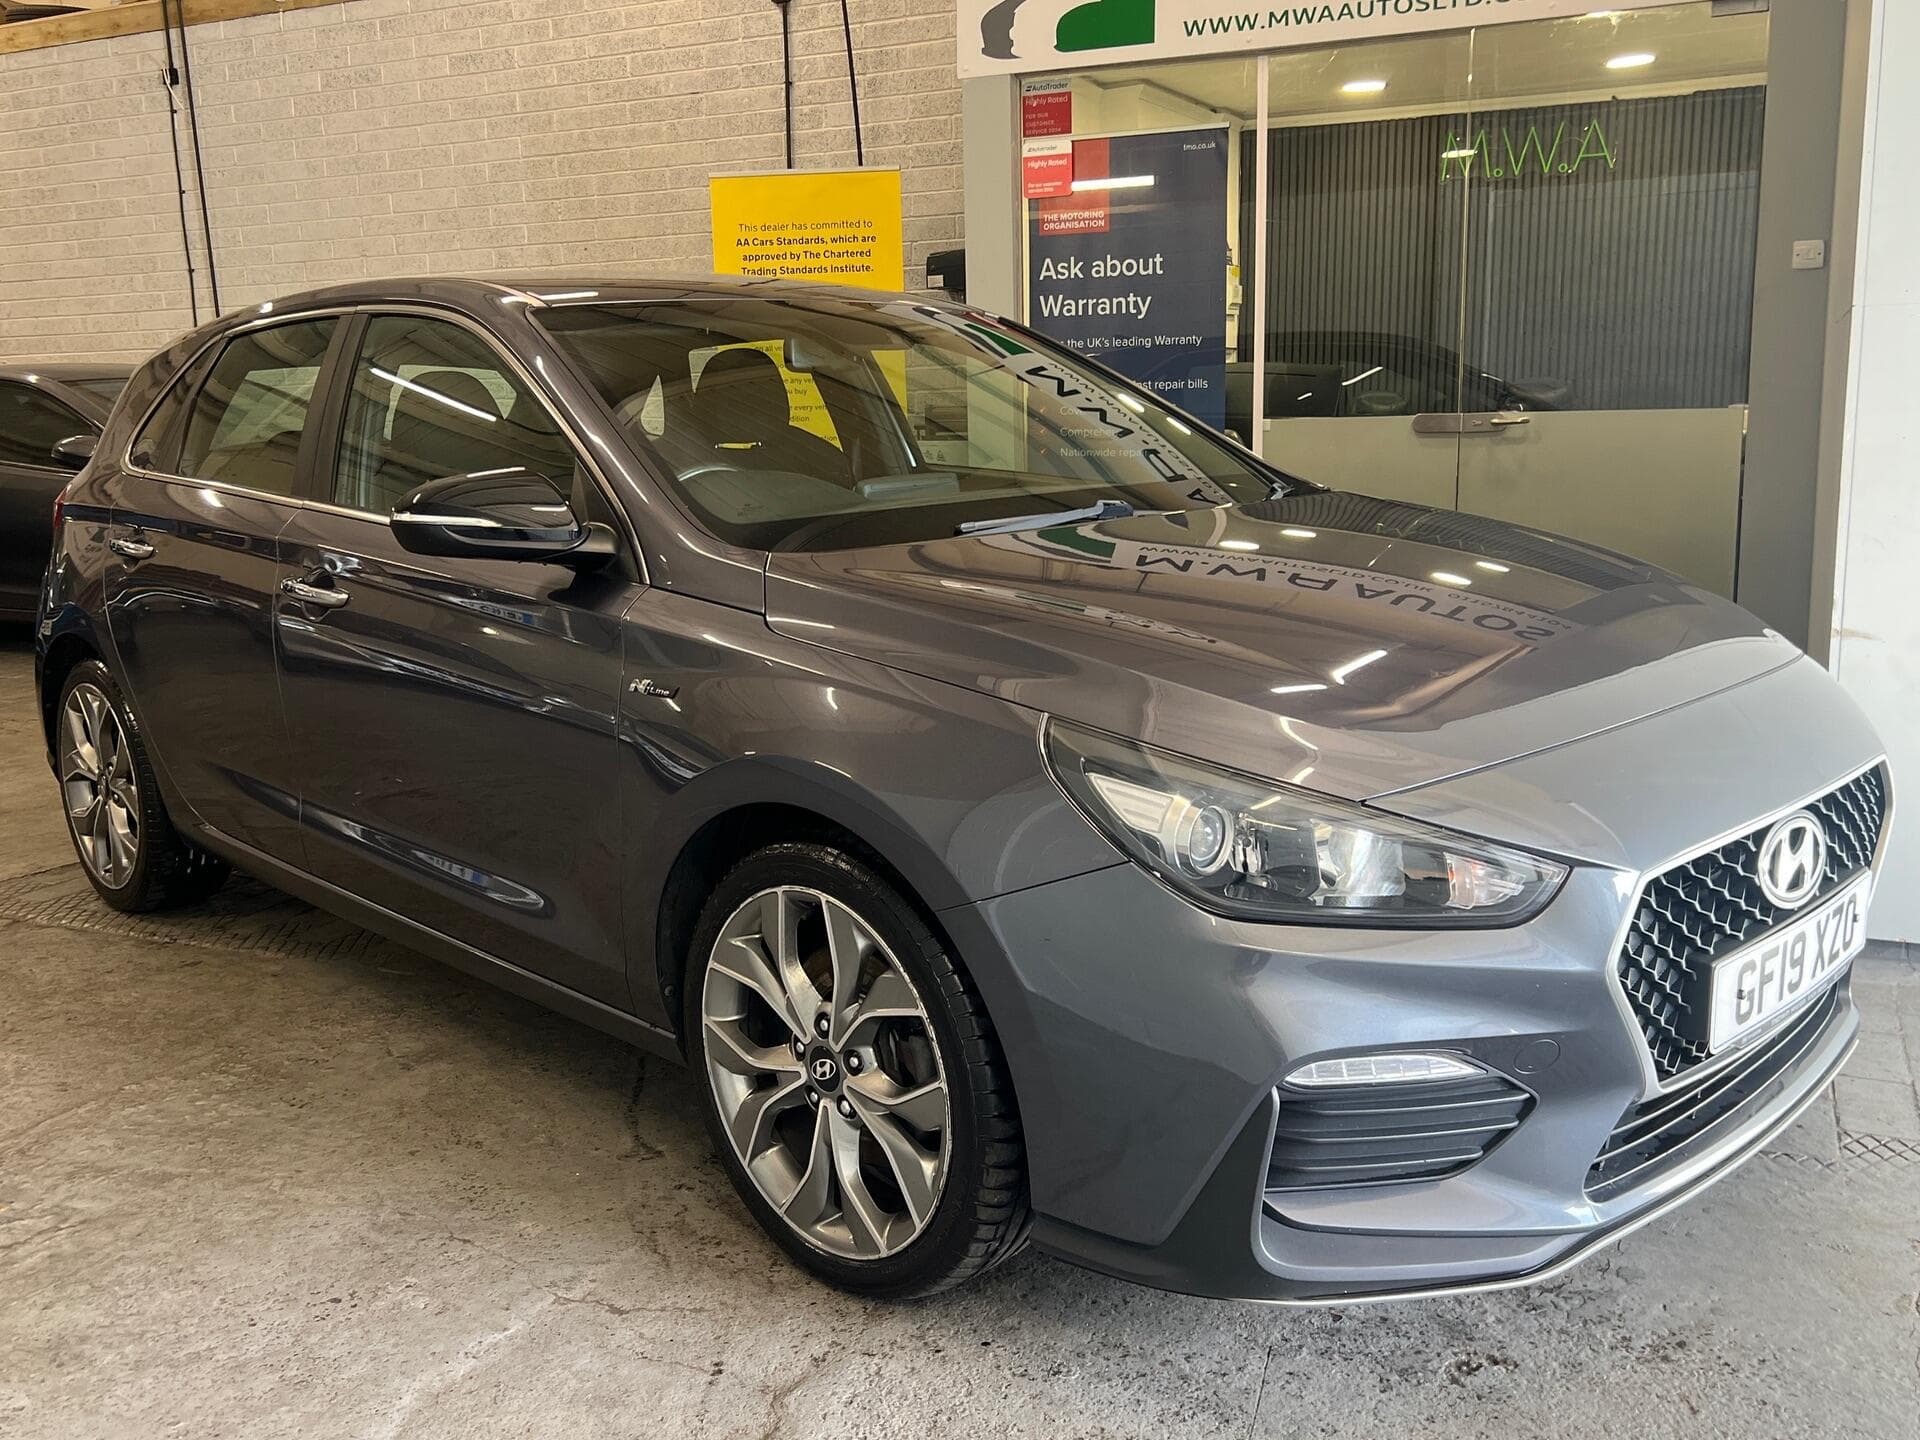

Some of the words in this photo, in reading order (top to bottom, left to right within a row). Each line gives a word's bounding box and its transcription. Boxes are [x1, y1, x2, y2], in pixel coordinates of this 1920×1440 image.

[1048, 94, 1068, 103] Rated
[1441, 119, 1613, 181] M.W.A
[1028, 160, 1048, 169] Highly
[1048, 158, 1067, 166] Rated
[1060, 210, 1104, 220] MOTORING
[739, 223, 758, 232] This
[760, 222, 789, 232] dealer
[792, 222, 808, 230] has
[810, 220, 860, 230] committed
[862, 220, 872, 228] to
[1044, 220, 1104, 230] ORGANISATION
[736, 238, 750, 247] AA
[752, 238, 774, 246] Cars
[776, 236, 828, 246] Standards,
[830, 234, 858, 244] which
[742, 252, 787, 264] approved
[789, 252, 800, 262] by
[802, 250, 820, 260] The
[823, 248, 872, 258] Chartered
[742, 267, 777, 278] Trading
[780, 265, 828, 275] Standards
[830, 264, 874, 272] Institute.
[1039, 256, 1084, 280] Ask
[1091, 253, 1164, 278] about
[1039, 292, 1152, 320] Warranty
[1068, 338, 1084, 348] the
[1087, 337, 1110, 348] UK's
[1112, 336, 1152, 348] leading
[1154, 335, 1202, 347] Warranty
[1154, 380, 1185, 391] repair
[1188, 378, 1208, 388] bills
[1060, 448, 1116, 458] Nationwide
[1735, 930, 1807, 1026] GF19
